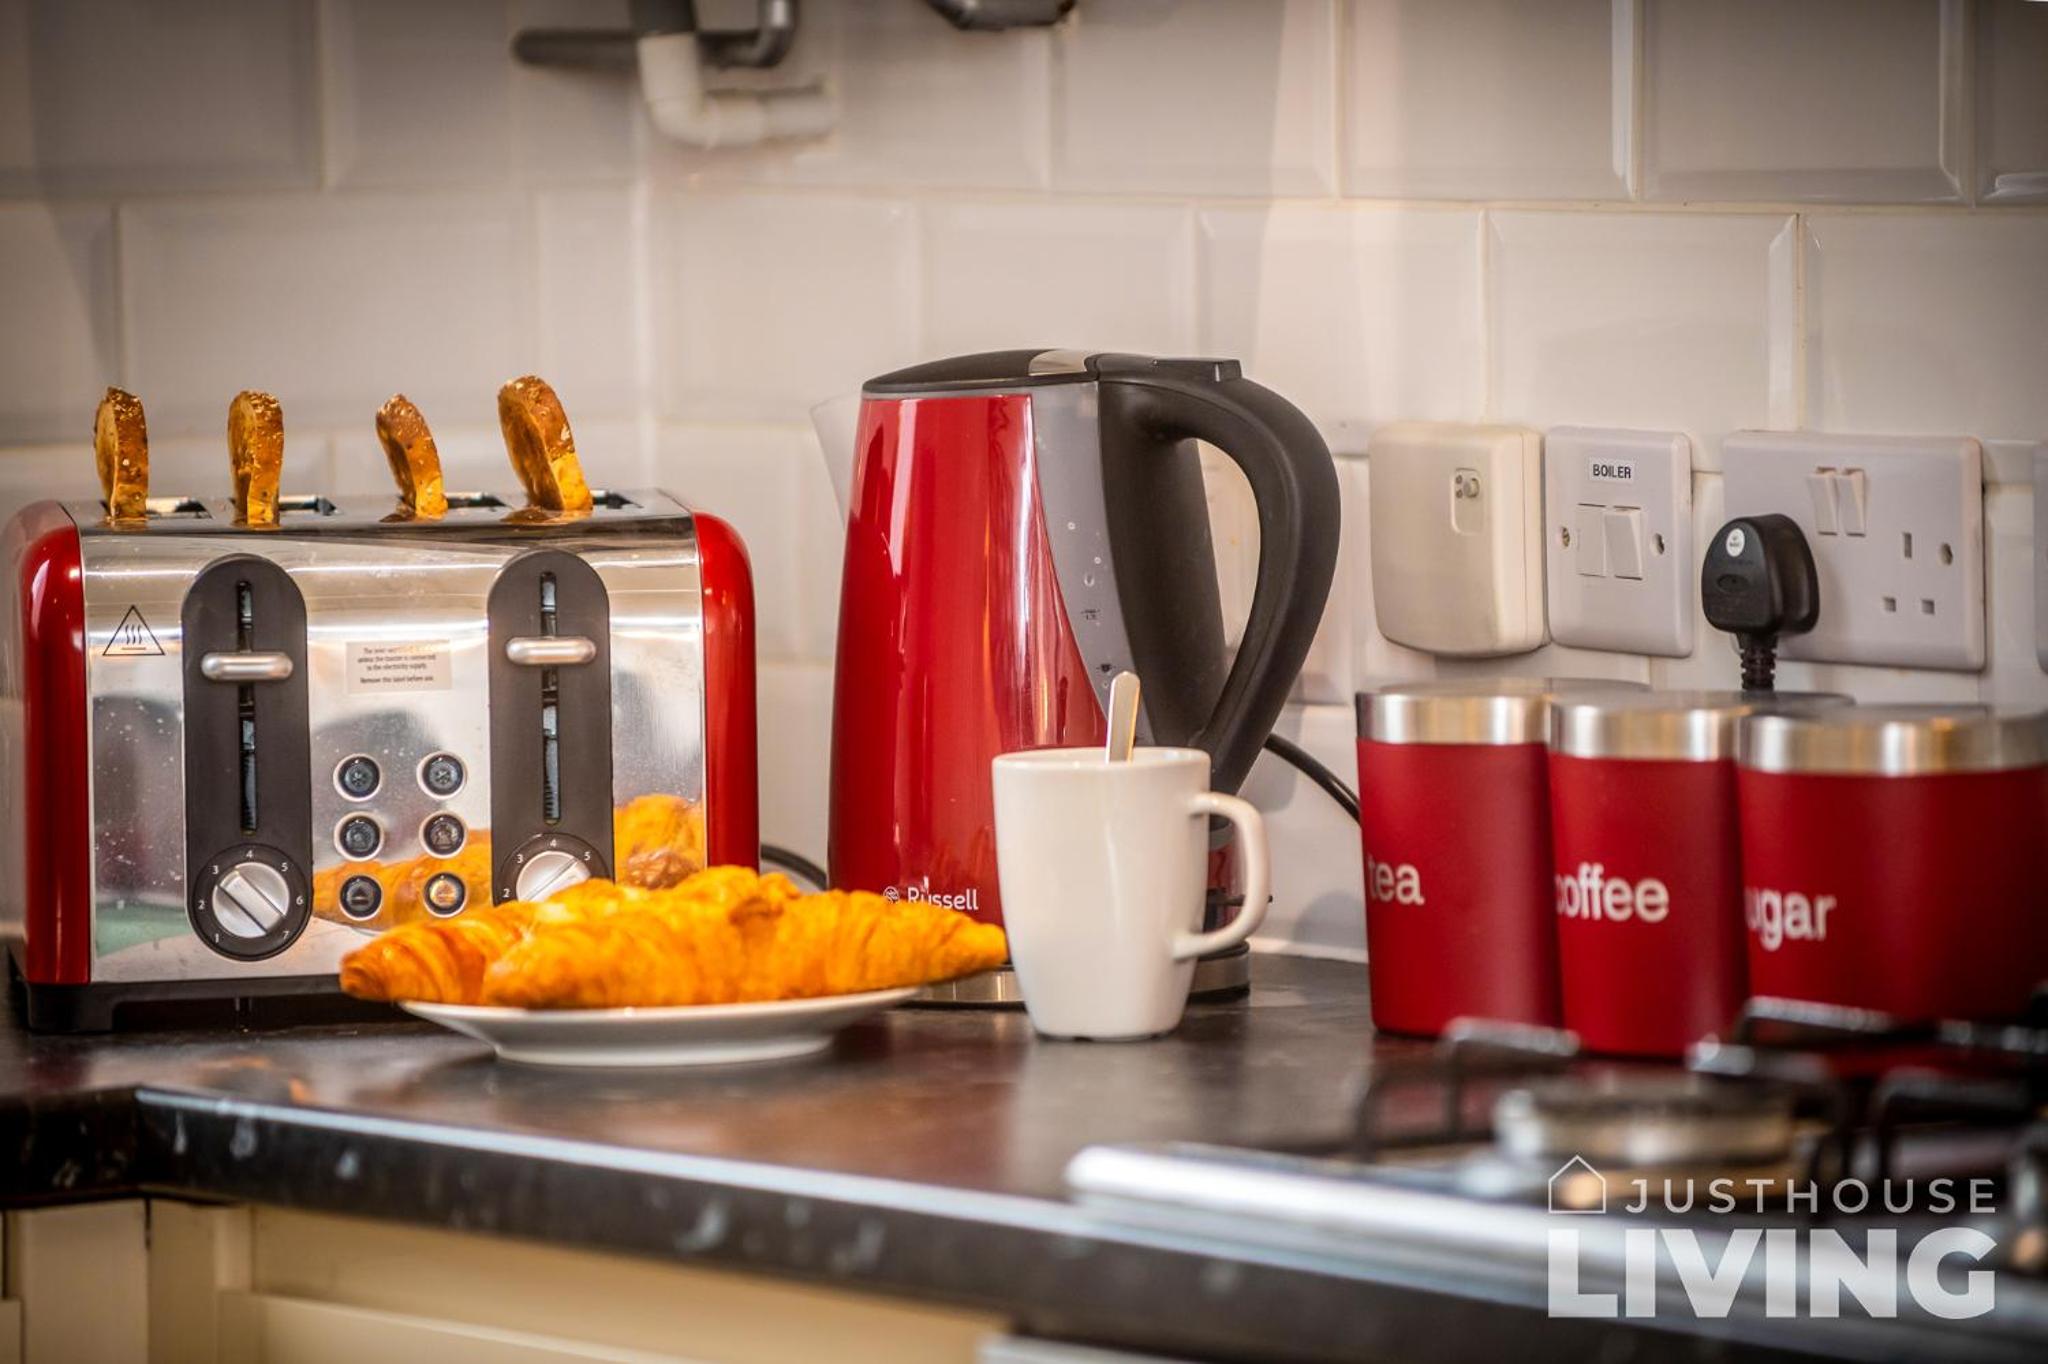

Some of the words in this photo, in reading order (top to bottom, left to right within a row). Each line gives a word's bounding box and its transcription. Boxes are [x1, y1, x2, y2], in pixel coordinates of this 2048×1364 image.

[1592, 464, 1631, 479] BOILER
[246, 850, 253, 858] 4
[212, 865, 219, 875] 3
[281, 862, 289, 872] 5
[502, 888, 511, 898] 2
[516, 854, 524, 864] 3
[549, 838, 557, 847] 4
[584, 851, 591, 861] 5
[1367, 853, 1426, 906] tea
[295, 896, 304, 905] 6
[907, 886, 979, 911] Russell
[198, 900, 205, 910] 2
[1744, 886, 1838, 953] ugar
[282, 931, 290, 940] 7
